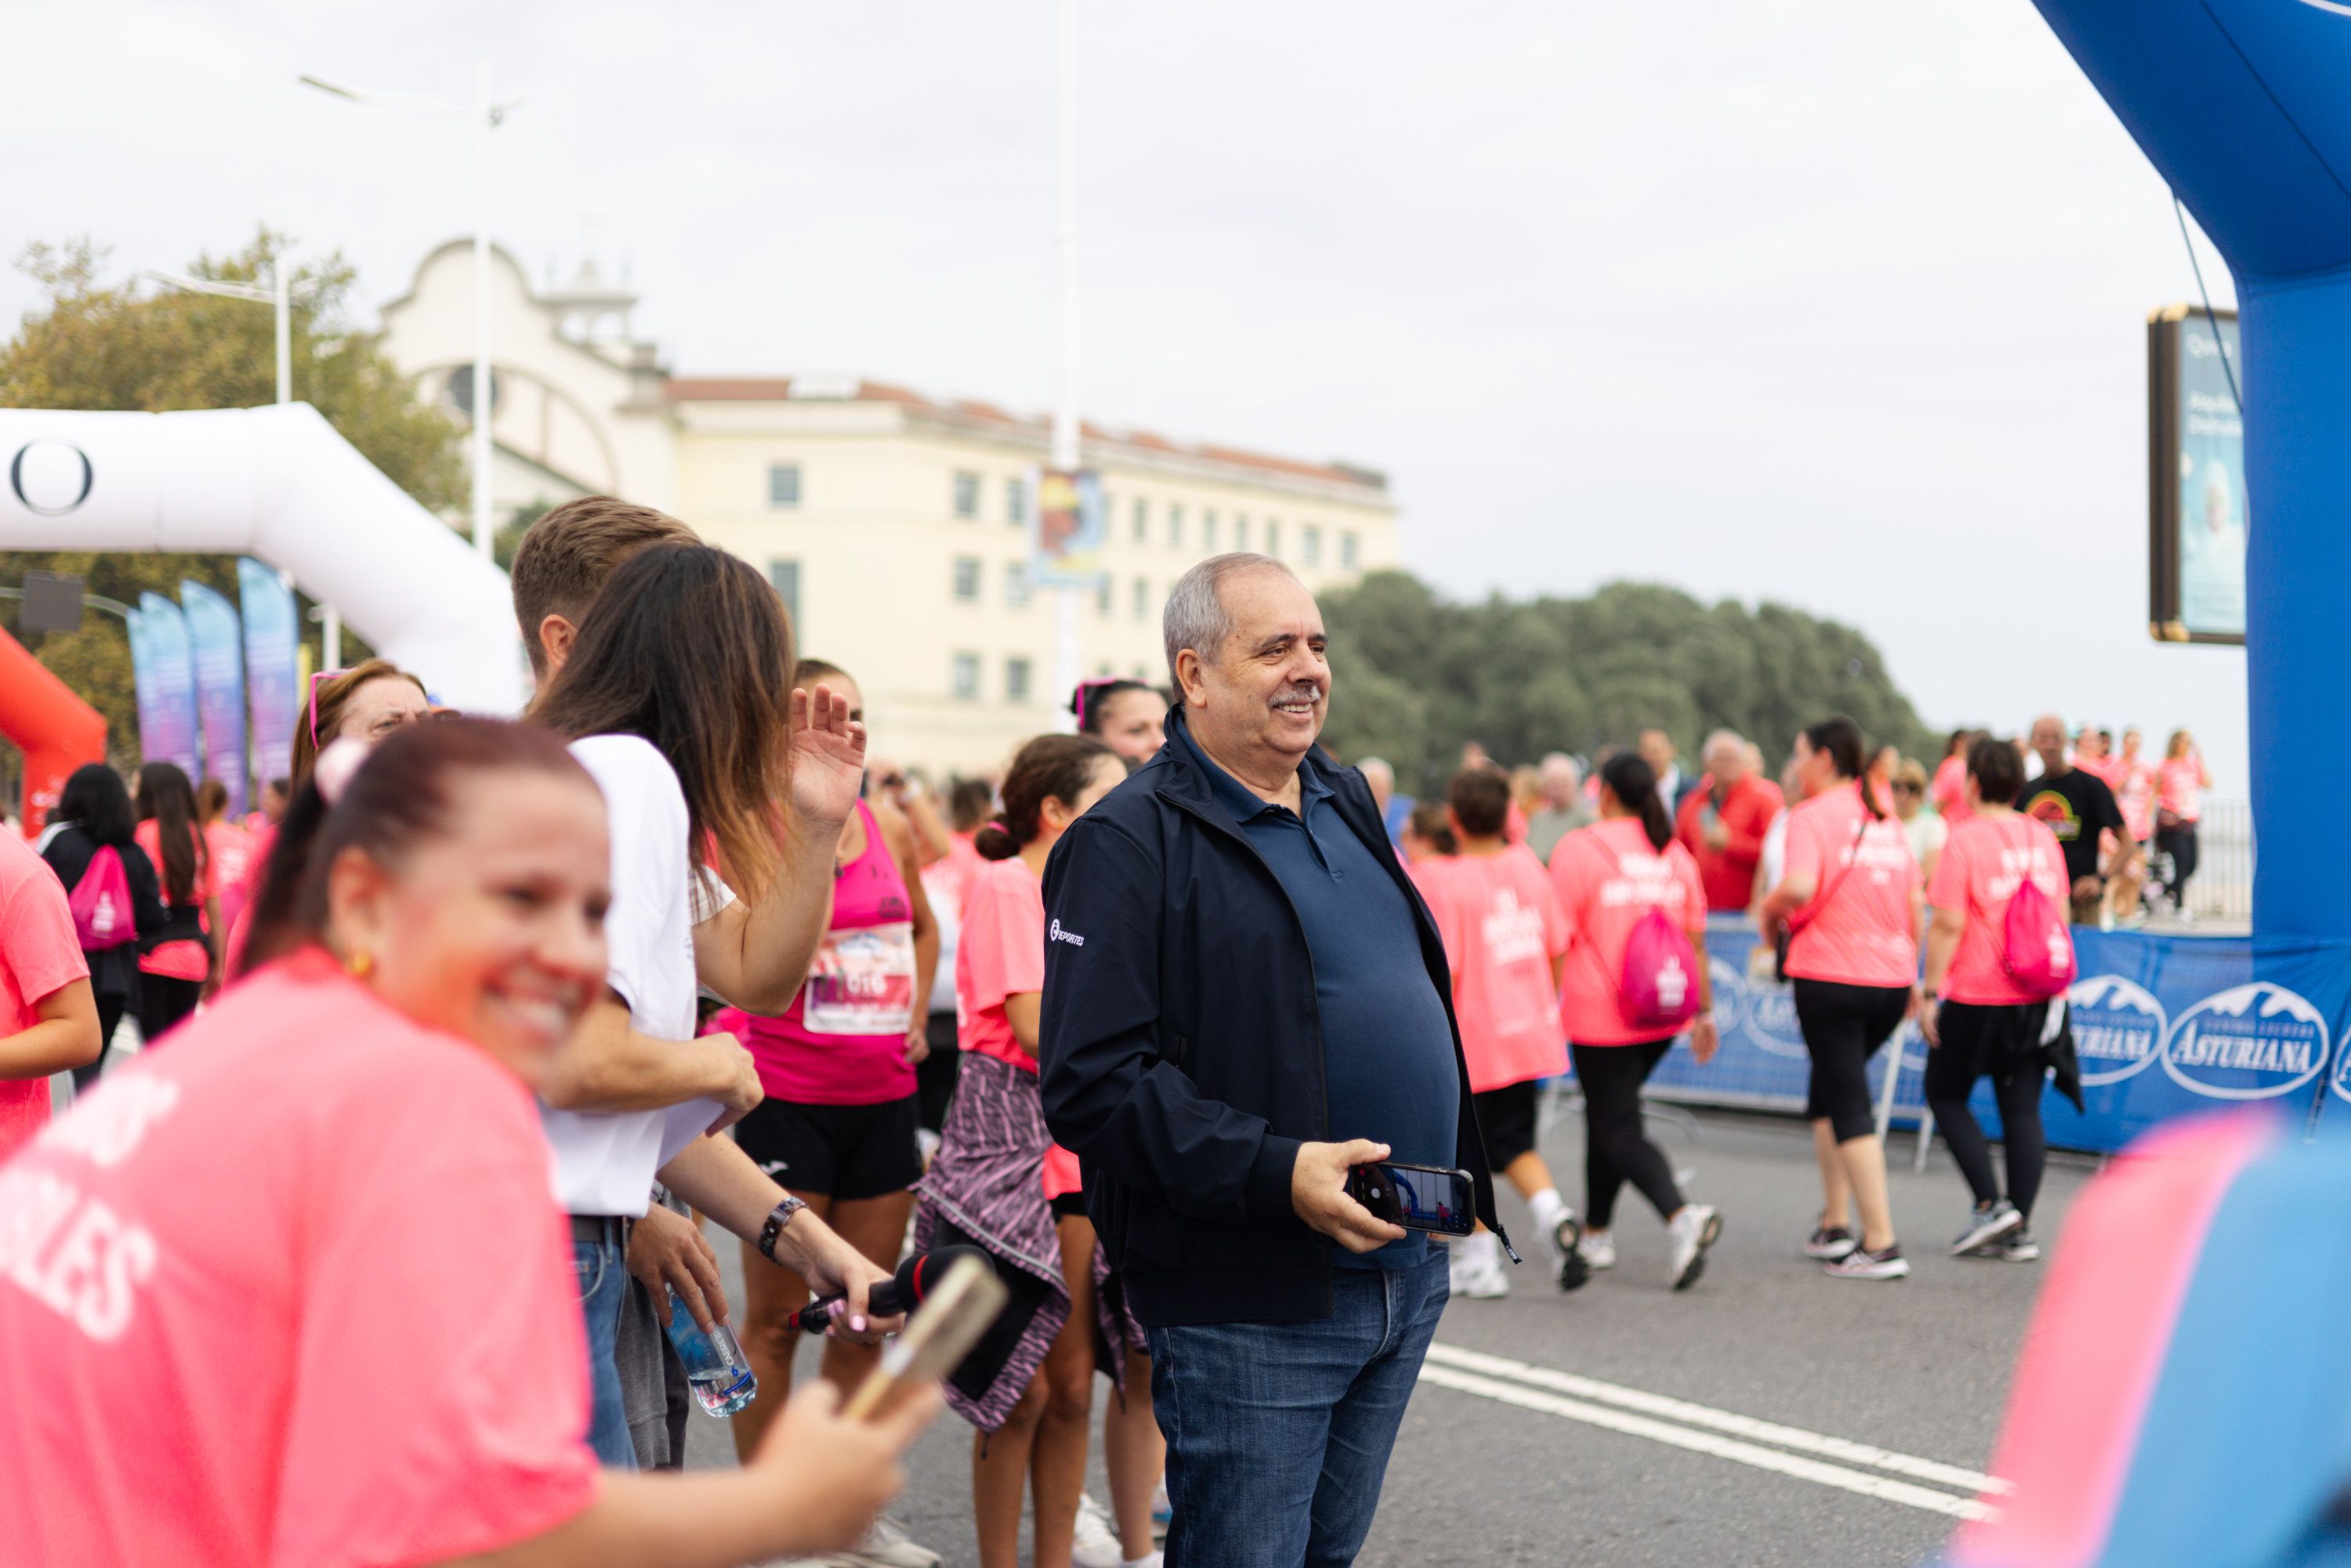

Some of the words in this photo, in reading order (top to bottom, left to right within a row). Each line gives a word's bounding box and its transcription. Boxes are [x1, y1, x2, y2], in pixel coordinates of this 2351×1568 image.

[2070, 1024, 2152, 1061] URIANA
[2171, 1017, 2312, 1074] ASTURIANA
[713, 1327, 734, 1366] CABREIR
